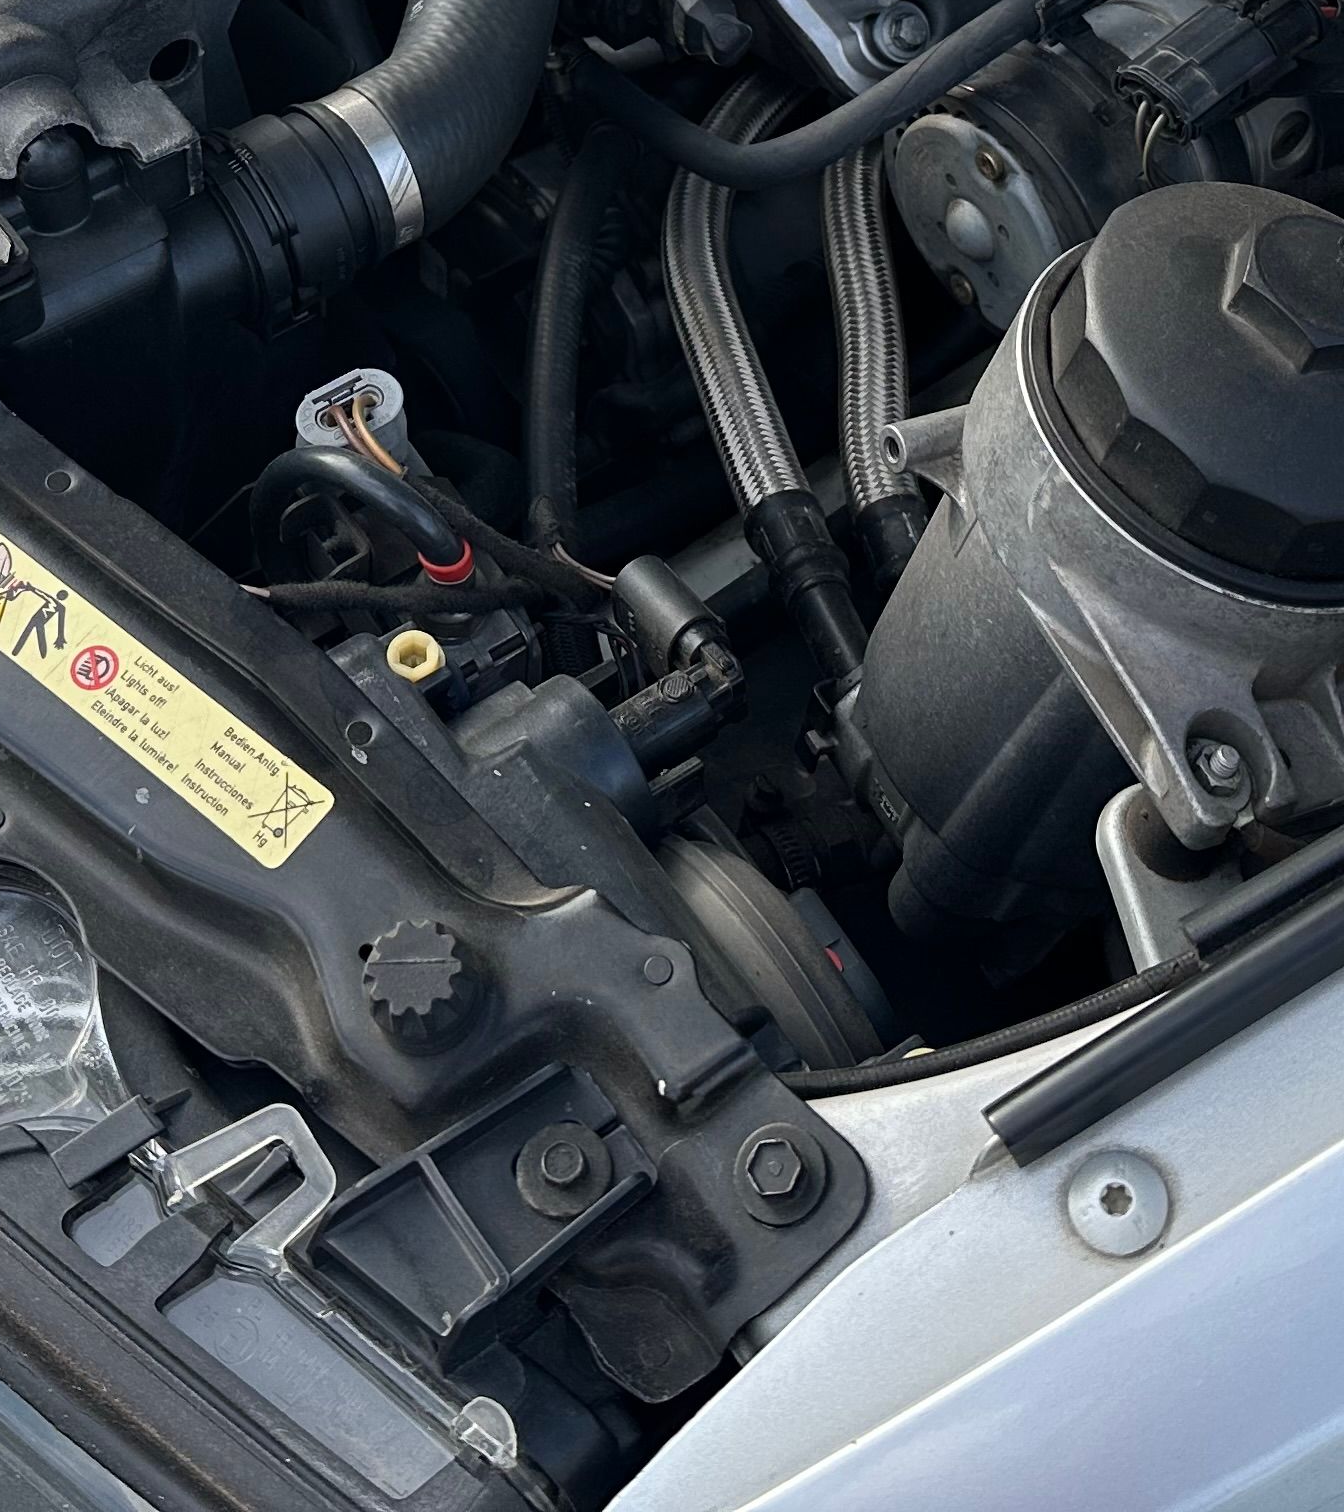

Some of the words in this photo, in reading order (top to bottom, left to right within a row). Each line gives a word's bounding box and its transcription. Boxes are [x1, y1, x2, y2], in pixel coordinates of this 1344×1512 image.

[120, 670, 153, 697] Lights
[134, 656, 162, 678] Licht
[157, 676, 181, 694] aus!
[104, 687, 143, 721] ¡Apagar
[138, 713, 152, 726] la
[149, 723, 170, 741] luz!
[126, 730, 141, 742] la
[139, 739, 179, 774] lumière!
[210, 742, 247, 773] Manual
[180, 774, 231, 816] Instruction
[194, 759, 256, 810] Instrucciones
[251, 830, 271, 849] Hg
